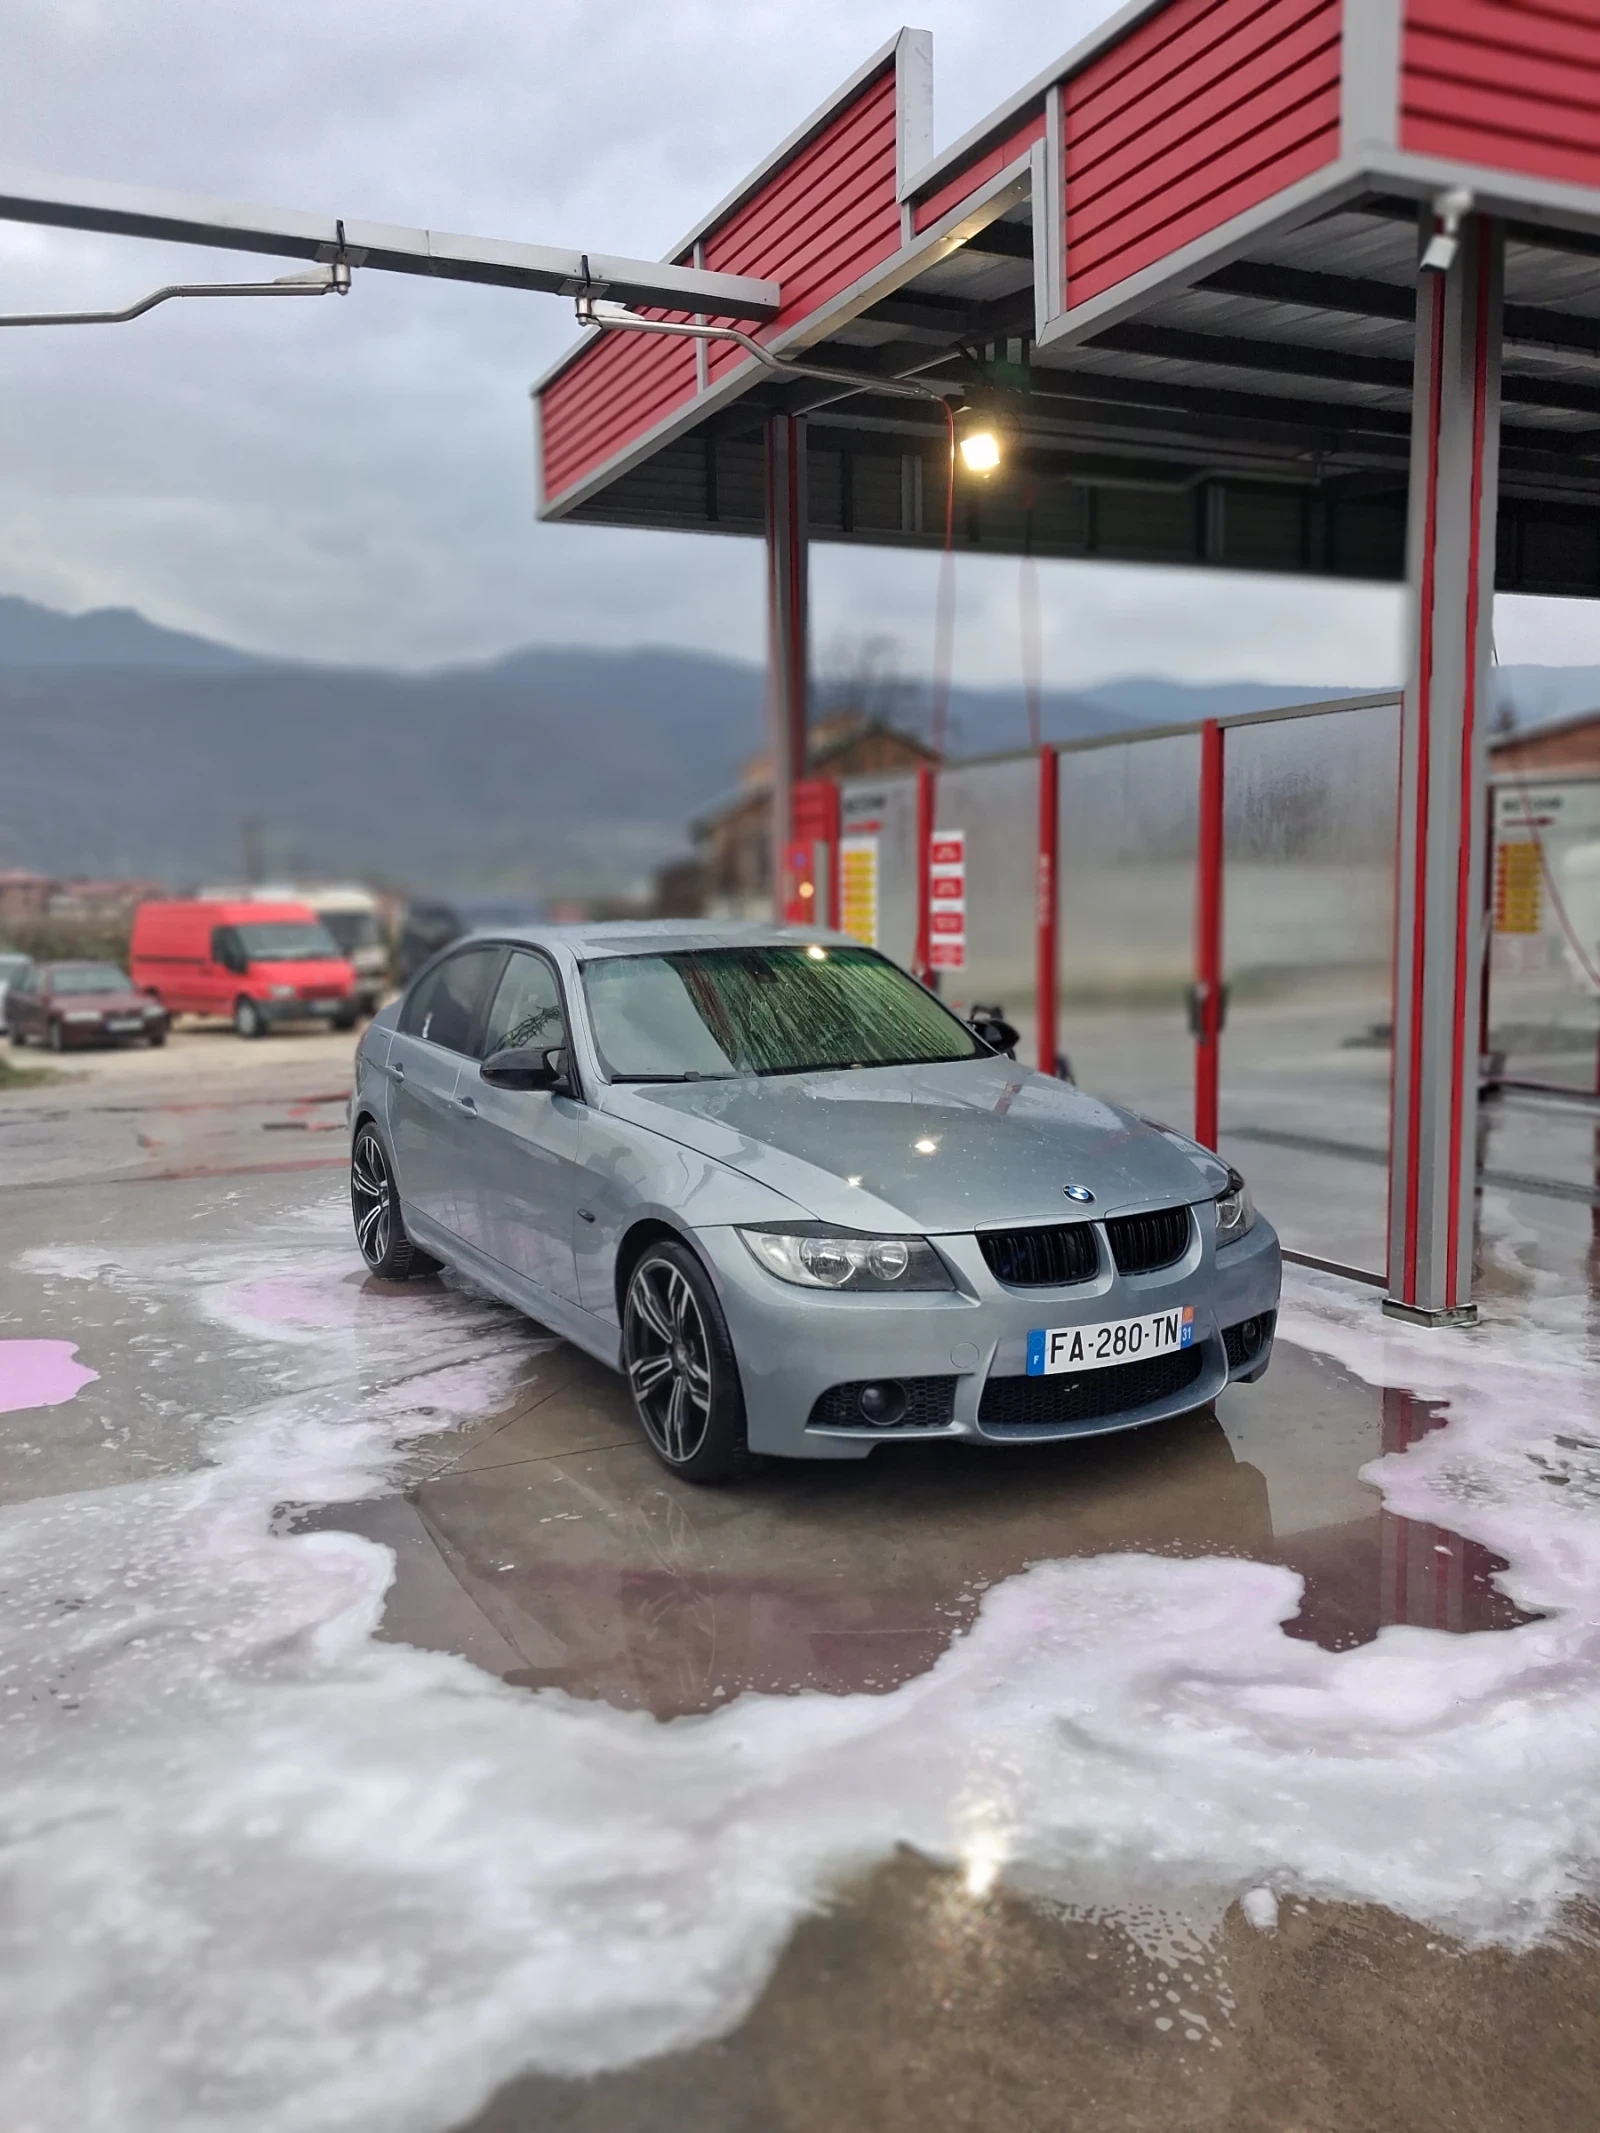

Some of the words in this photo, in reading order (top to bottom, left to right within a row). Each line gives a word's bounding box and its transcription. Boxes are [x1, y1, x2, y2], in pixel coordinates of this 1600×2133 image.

[1050, 1313, 1179, 1364] FA-280-TN
[1182, 1328, 1192, 1340] 31
[1033, 1355, 1040, 1365] F
